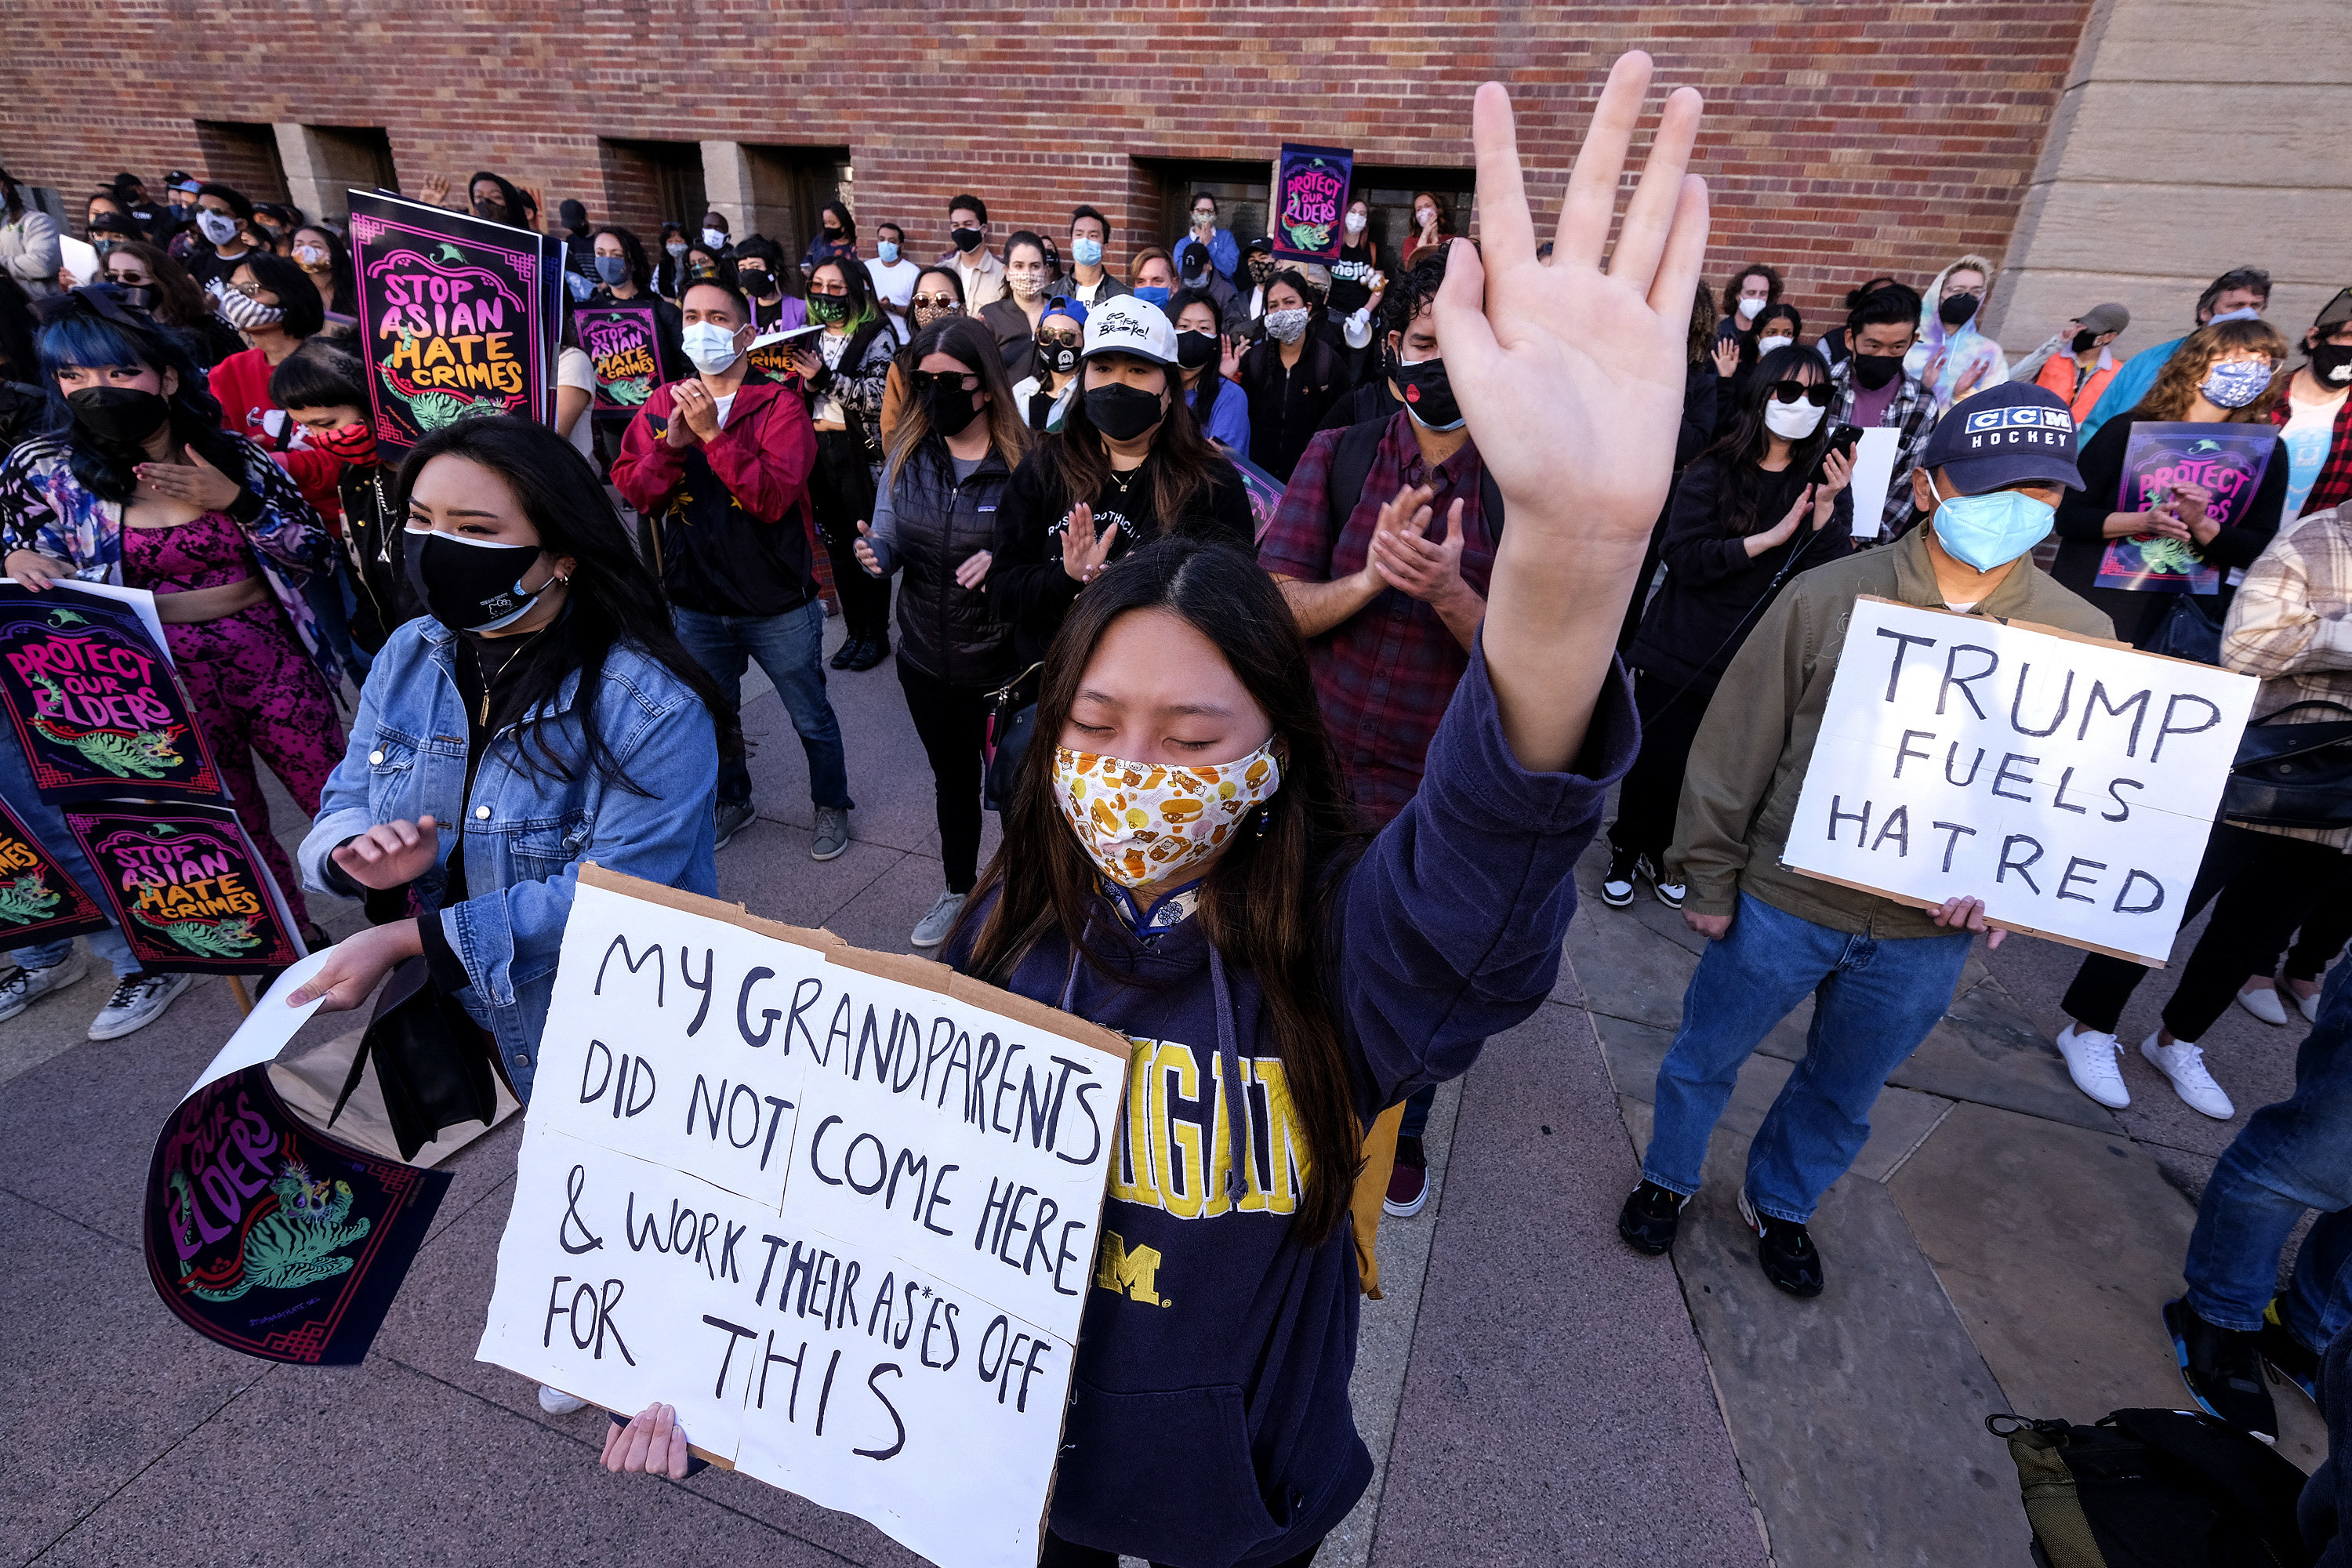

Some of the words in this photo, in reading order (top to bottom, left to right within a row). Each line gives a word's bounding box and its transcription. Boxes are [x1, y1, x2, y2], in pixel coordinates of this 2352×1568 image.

[1287, 172, 1341, 199] PROTECT
[1301, 192, 1324, 203] OUR
[1287, 199, 1336, 223] ELDERS
[384, 274, 474, 307] STOP
[379, 296, 503, 340] ASIAN
[1106, 312, 1126, 321] GO
[393, 331, 514, 369] HATE
[590, 327, 627, 345] STOP
[591, 331, 642, 362] ASIAN
[747, 343, 798, 358] ATE
[598, 344, 649, 374] HATE
[607, 357, 655, 379] CRIMES
[747, 354, 798, 372] RIME
[412, 361, 523, 394] CRIMES
[1972, 408, 2071, 429] CCM
[1972, 431, 2067, 448] HOCKEY
[2140, 459, 2250, 501] PROTECT
[1048, 516, 1069, 536] ROS
[5, 635, 154, 688] PROTECT
[64, 676, 127, 695] OUR
[1876, 626, 2222, 764] TRUMP
[32, 686, 173, 730] ELDERS
[1893, 728, 2145, 823] FUELS
[113, 845, 195, 868] STOP
[1827, 794, 2165, 915] HATRED
[122, 851, 230, 892] ASIAN
[139, 872, 246, 910] HATE
[160, 891, 260, 919] CRIMES
[593, 934, 713, 1038] MY
[737, 965, 1102, 1167] GRANDPARENTS
[169, 1091, 278, 1260] ELDERS
[579, 1039, 656, 1119] DID
[686, 1074, 794, 1171] NOT
[810, 1115, 960, 1236] COME
[974, 1175, 1086, 1297] HERE
[560, 1164, 604, 1256] &
[626, 1191, 746, 1283] WORK
[753, 1233, 862, 1332] THEIR
[978, 1314, 1052, 1414] OFF
[544, 1275, 636, 1367] FOR
[702, 1314, 907, 1461] THIS
